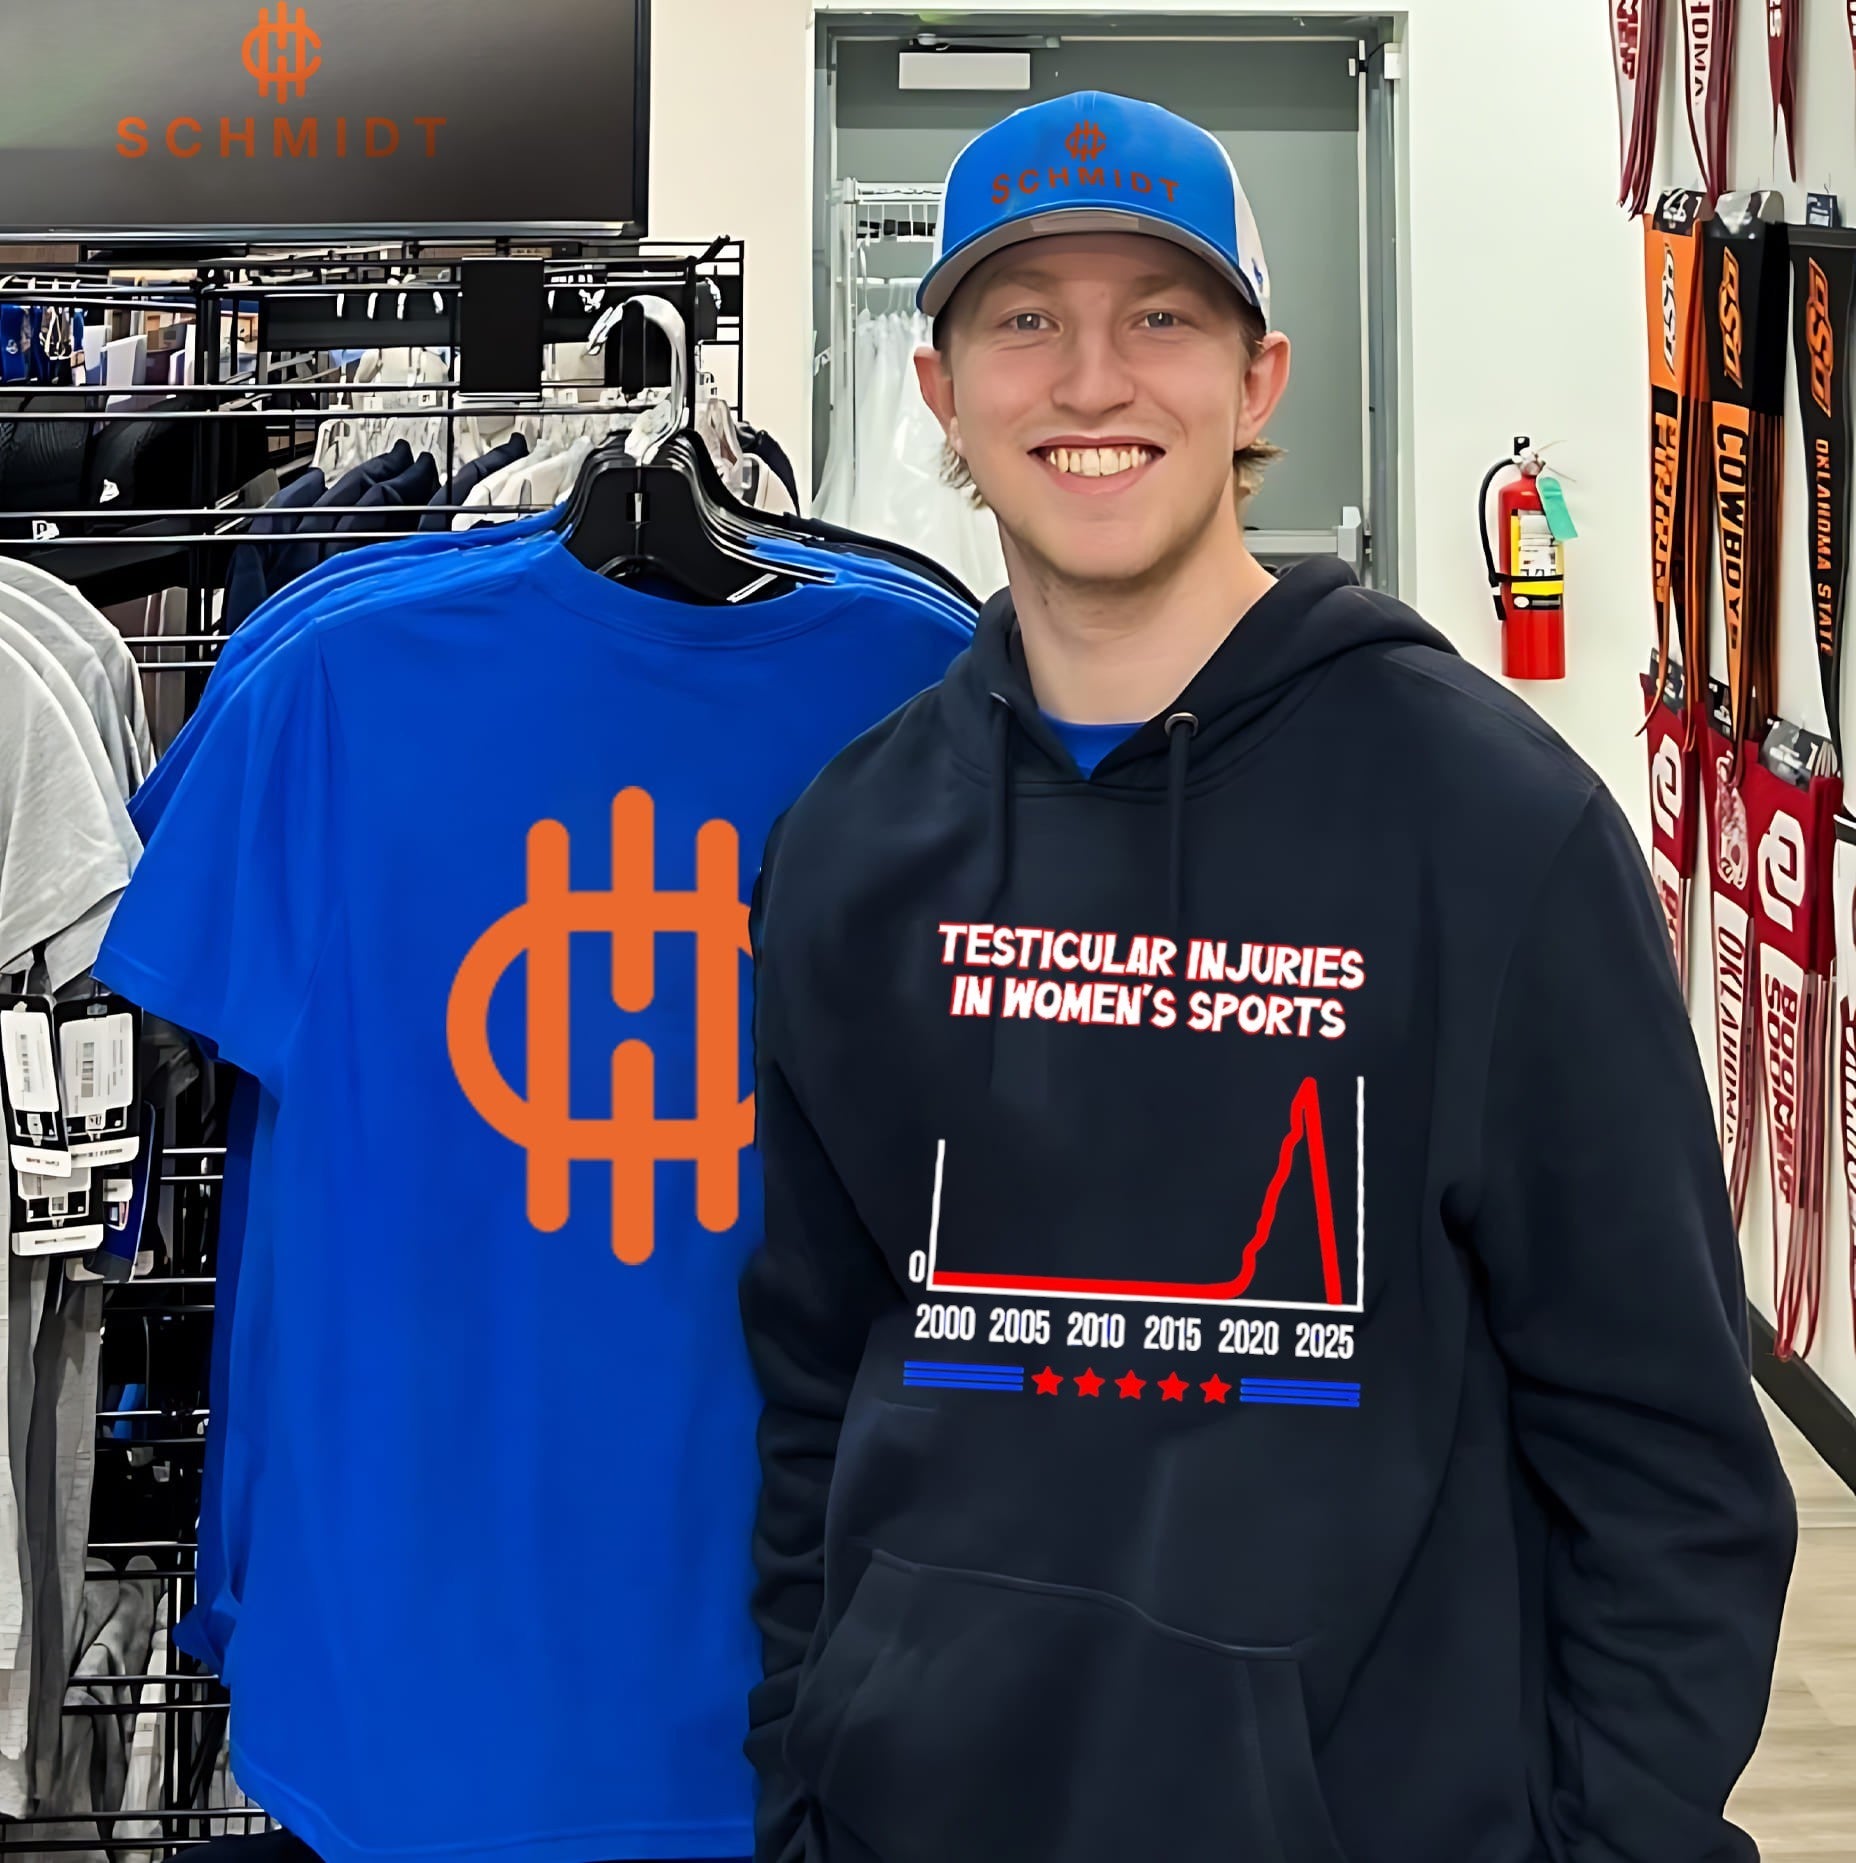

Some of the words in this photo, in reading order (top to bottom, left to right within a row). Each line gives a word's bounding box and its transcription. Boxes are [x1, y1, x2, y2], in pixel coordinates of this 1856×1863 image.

[114, 116, 449, 159] SCHMIDT
[991, 167, 1179, 204] SCHMIDT
[1815, 438, 1832, 570] OKLAHOMA
[938, 922, 1178, 977] TESTICULAR
[1184, 938, 1366, 991] INJURIES
[950, 974, 995, 1017] IN
[1001, 977, 1178, 1029] WOMEN'S
[1186, 990, 1347, 1040] SPORTS
[1718, 925, 1745, 1143] OKLAHOMA
[908, 1249, 927, 1284] 0
[914, 1303, 976, 1341] 2000
[988, 1307, 1051, 1345] 2005
[1066, 1311, 1126, 1349] 2010
[1143, 1314, 1202, 1352] 2015
[1218, 1318, 1280, 1356] 2020
[1294, 1322, 1355, 1360] 2025
